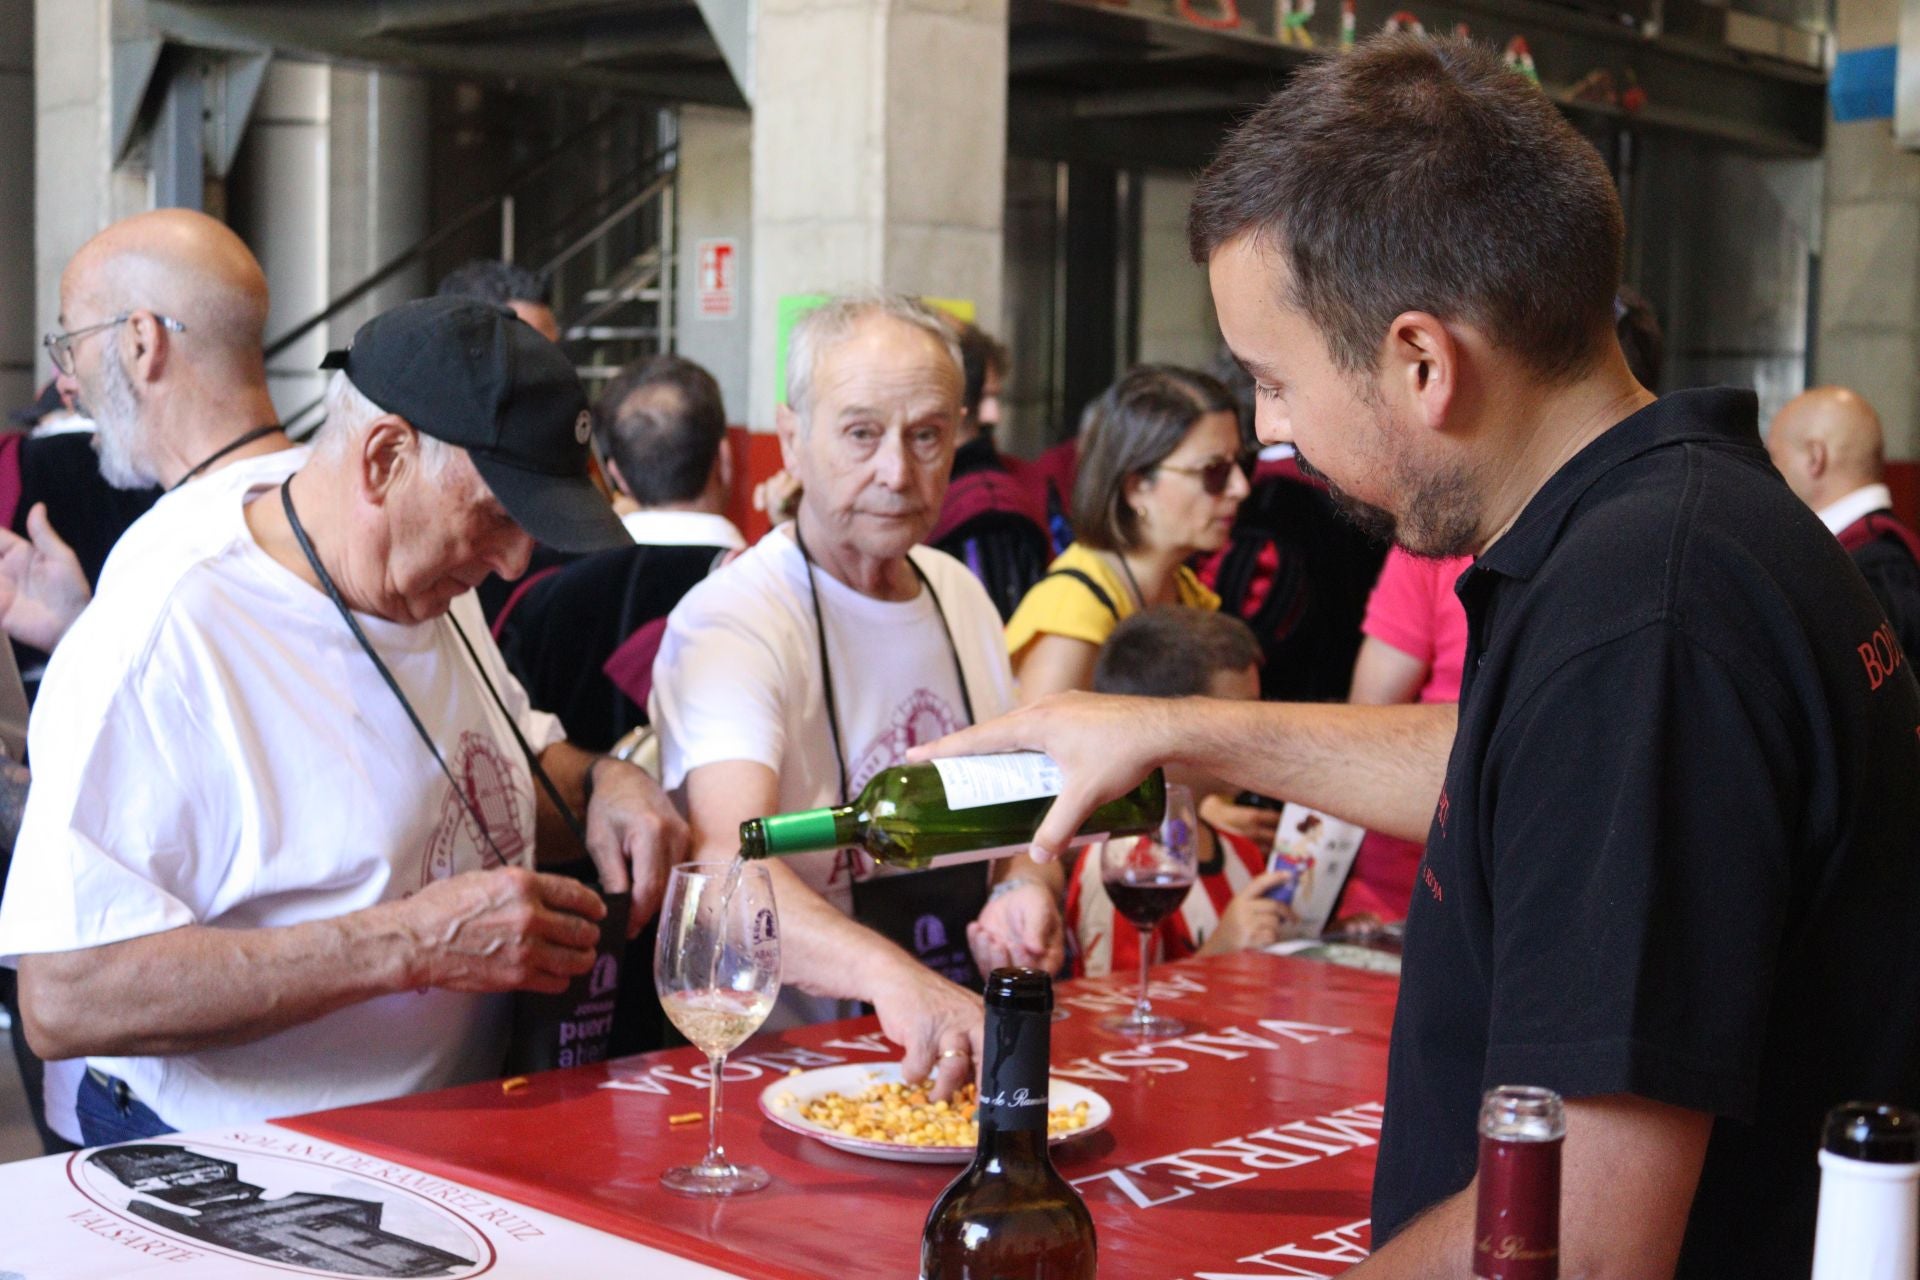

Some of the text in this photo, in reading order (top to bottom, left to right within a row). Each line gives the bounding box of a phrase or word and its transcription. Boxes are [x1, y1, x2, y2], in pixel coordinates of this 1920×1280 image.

[597, 1047, 847, 1095] RIOJA
[1048, 1019, 1353, 1083] VALSA
[223, 1132, 545, 1242] SOLANA DE RAMIREZ RUIZ
[1069, 1102, 1385, 1209] MIREZ
[65, 1208, 206, 1262] VALSARTE
